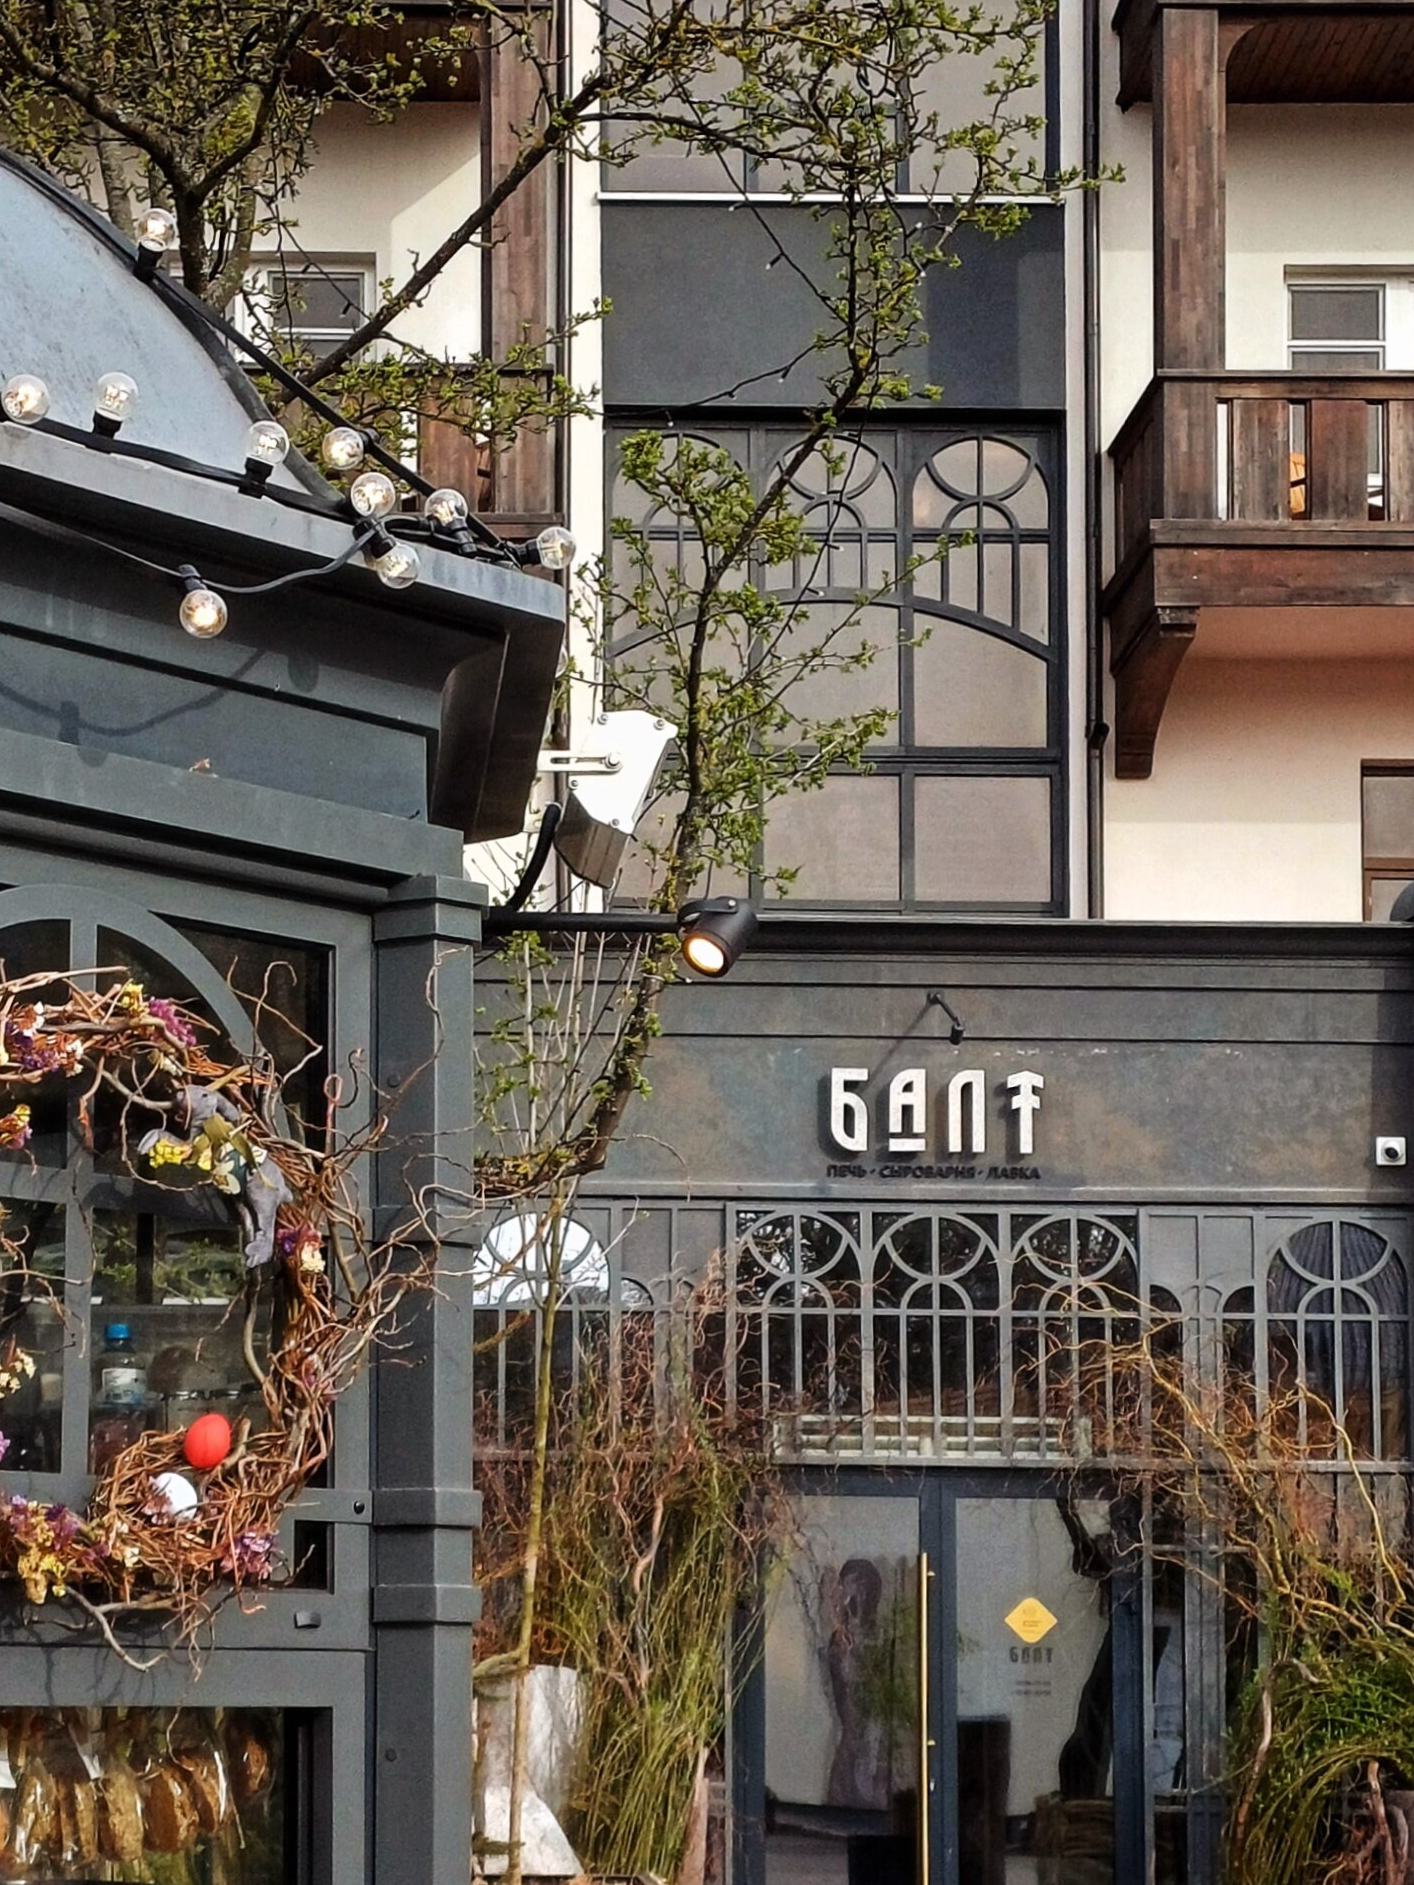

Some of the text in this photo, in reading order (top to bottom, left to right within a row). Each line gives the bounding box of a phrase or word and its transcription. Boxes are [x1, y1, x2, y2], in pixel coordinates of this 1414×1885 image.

[826, 1165, 1041, 1180] ПЕЧЬ СЫРОВАРНЯ ЛАВКА
